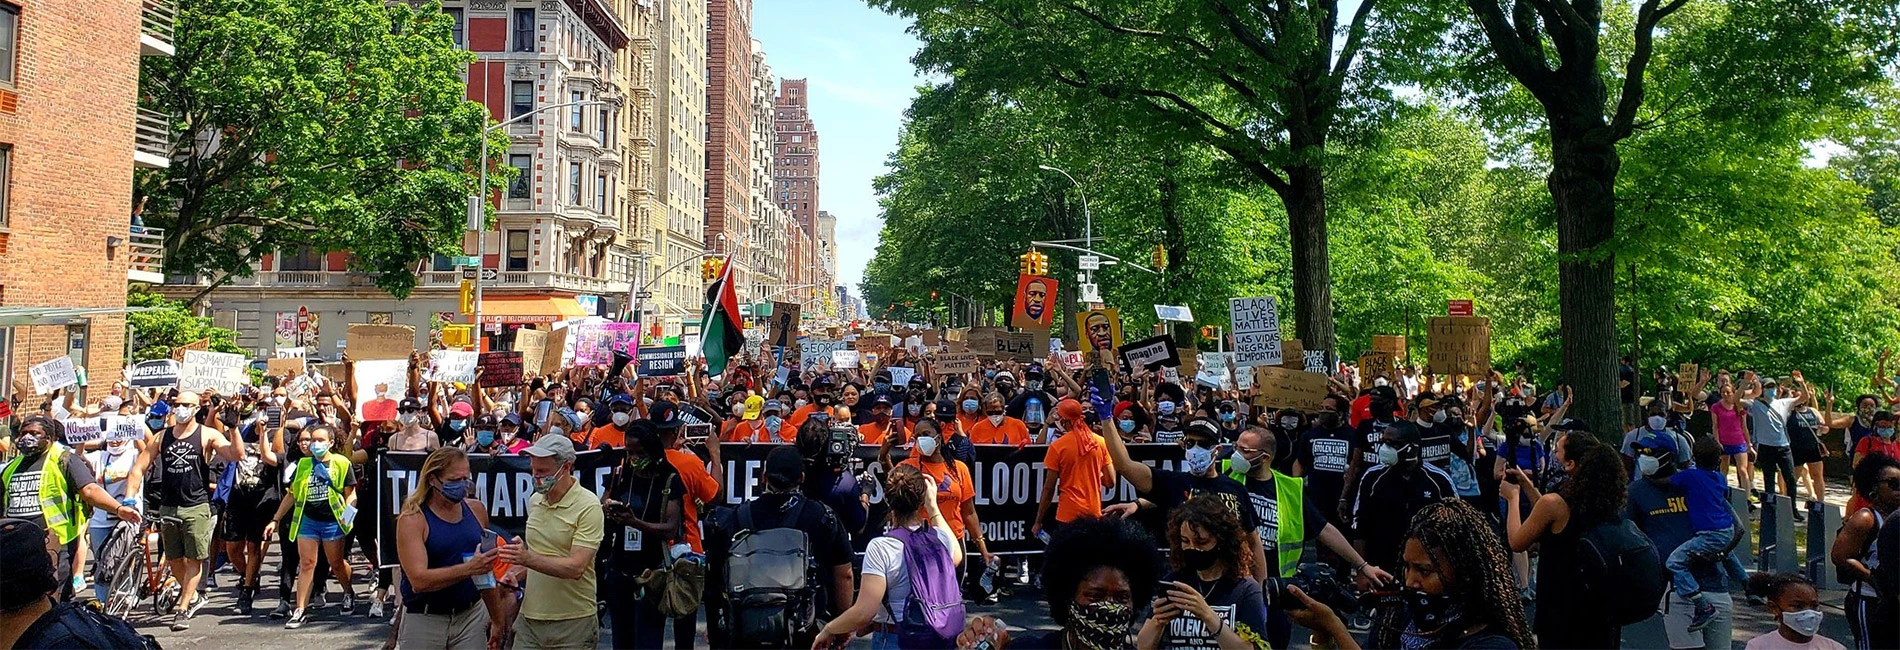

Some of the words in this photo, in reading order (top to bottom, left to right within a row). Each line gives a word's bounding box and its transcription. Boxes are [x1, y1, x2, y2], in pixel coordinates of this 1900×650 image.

[1234, 298, 1274, 312] BLACK
[1235, 309, 1275, 321] LIVES
[1234, 318, 1276, 330] MATTER
[1236, 335, 1252, 344] LAS
[1255, 332, 1280, 342] VIDAS
[802, 343, 844, 352] GEORGE
[997, 339, 1033, 354] BLM
[1238, 342, 1276, 352] NEGRAS
[186, 352, 243, 368] DISMANTLE
[639, 352, 673, 360] COMMISSIONER
[1236, 350, 1281, 362] IMPORTAN
[1302, 357, 1324, 367] LIVES
[1366, 355, 1388, 368] BLACK
[650, 360, 674, 370] RESIGN
[1365, 364, 1387, 376] LIVES
[195, 367, 226, 378] WHITE
[184, 376, 238, 392] SUPREMACY
[67, 422, 77, 434] NO
[1332, 446, 1346, 454] LIVES
[1328, 456, 1345, 465] DREAMS
[28, 480, 40, 490] LIVE
[1667, 496, 1688, 512] 5K
[1261, 506, 1278, 522] LIVE
[980, 520, 1026, 541] POLICE
